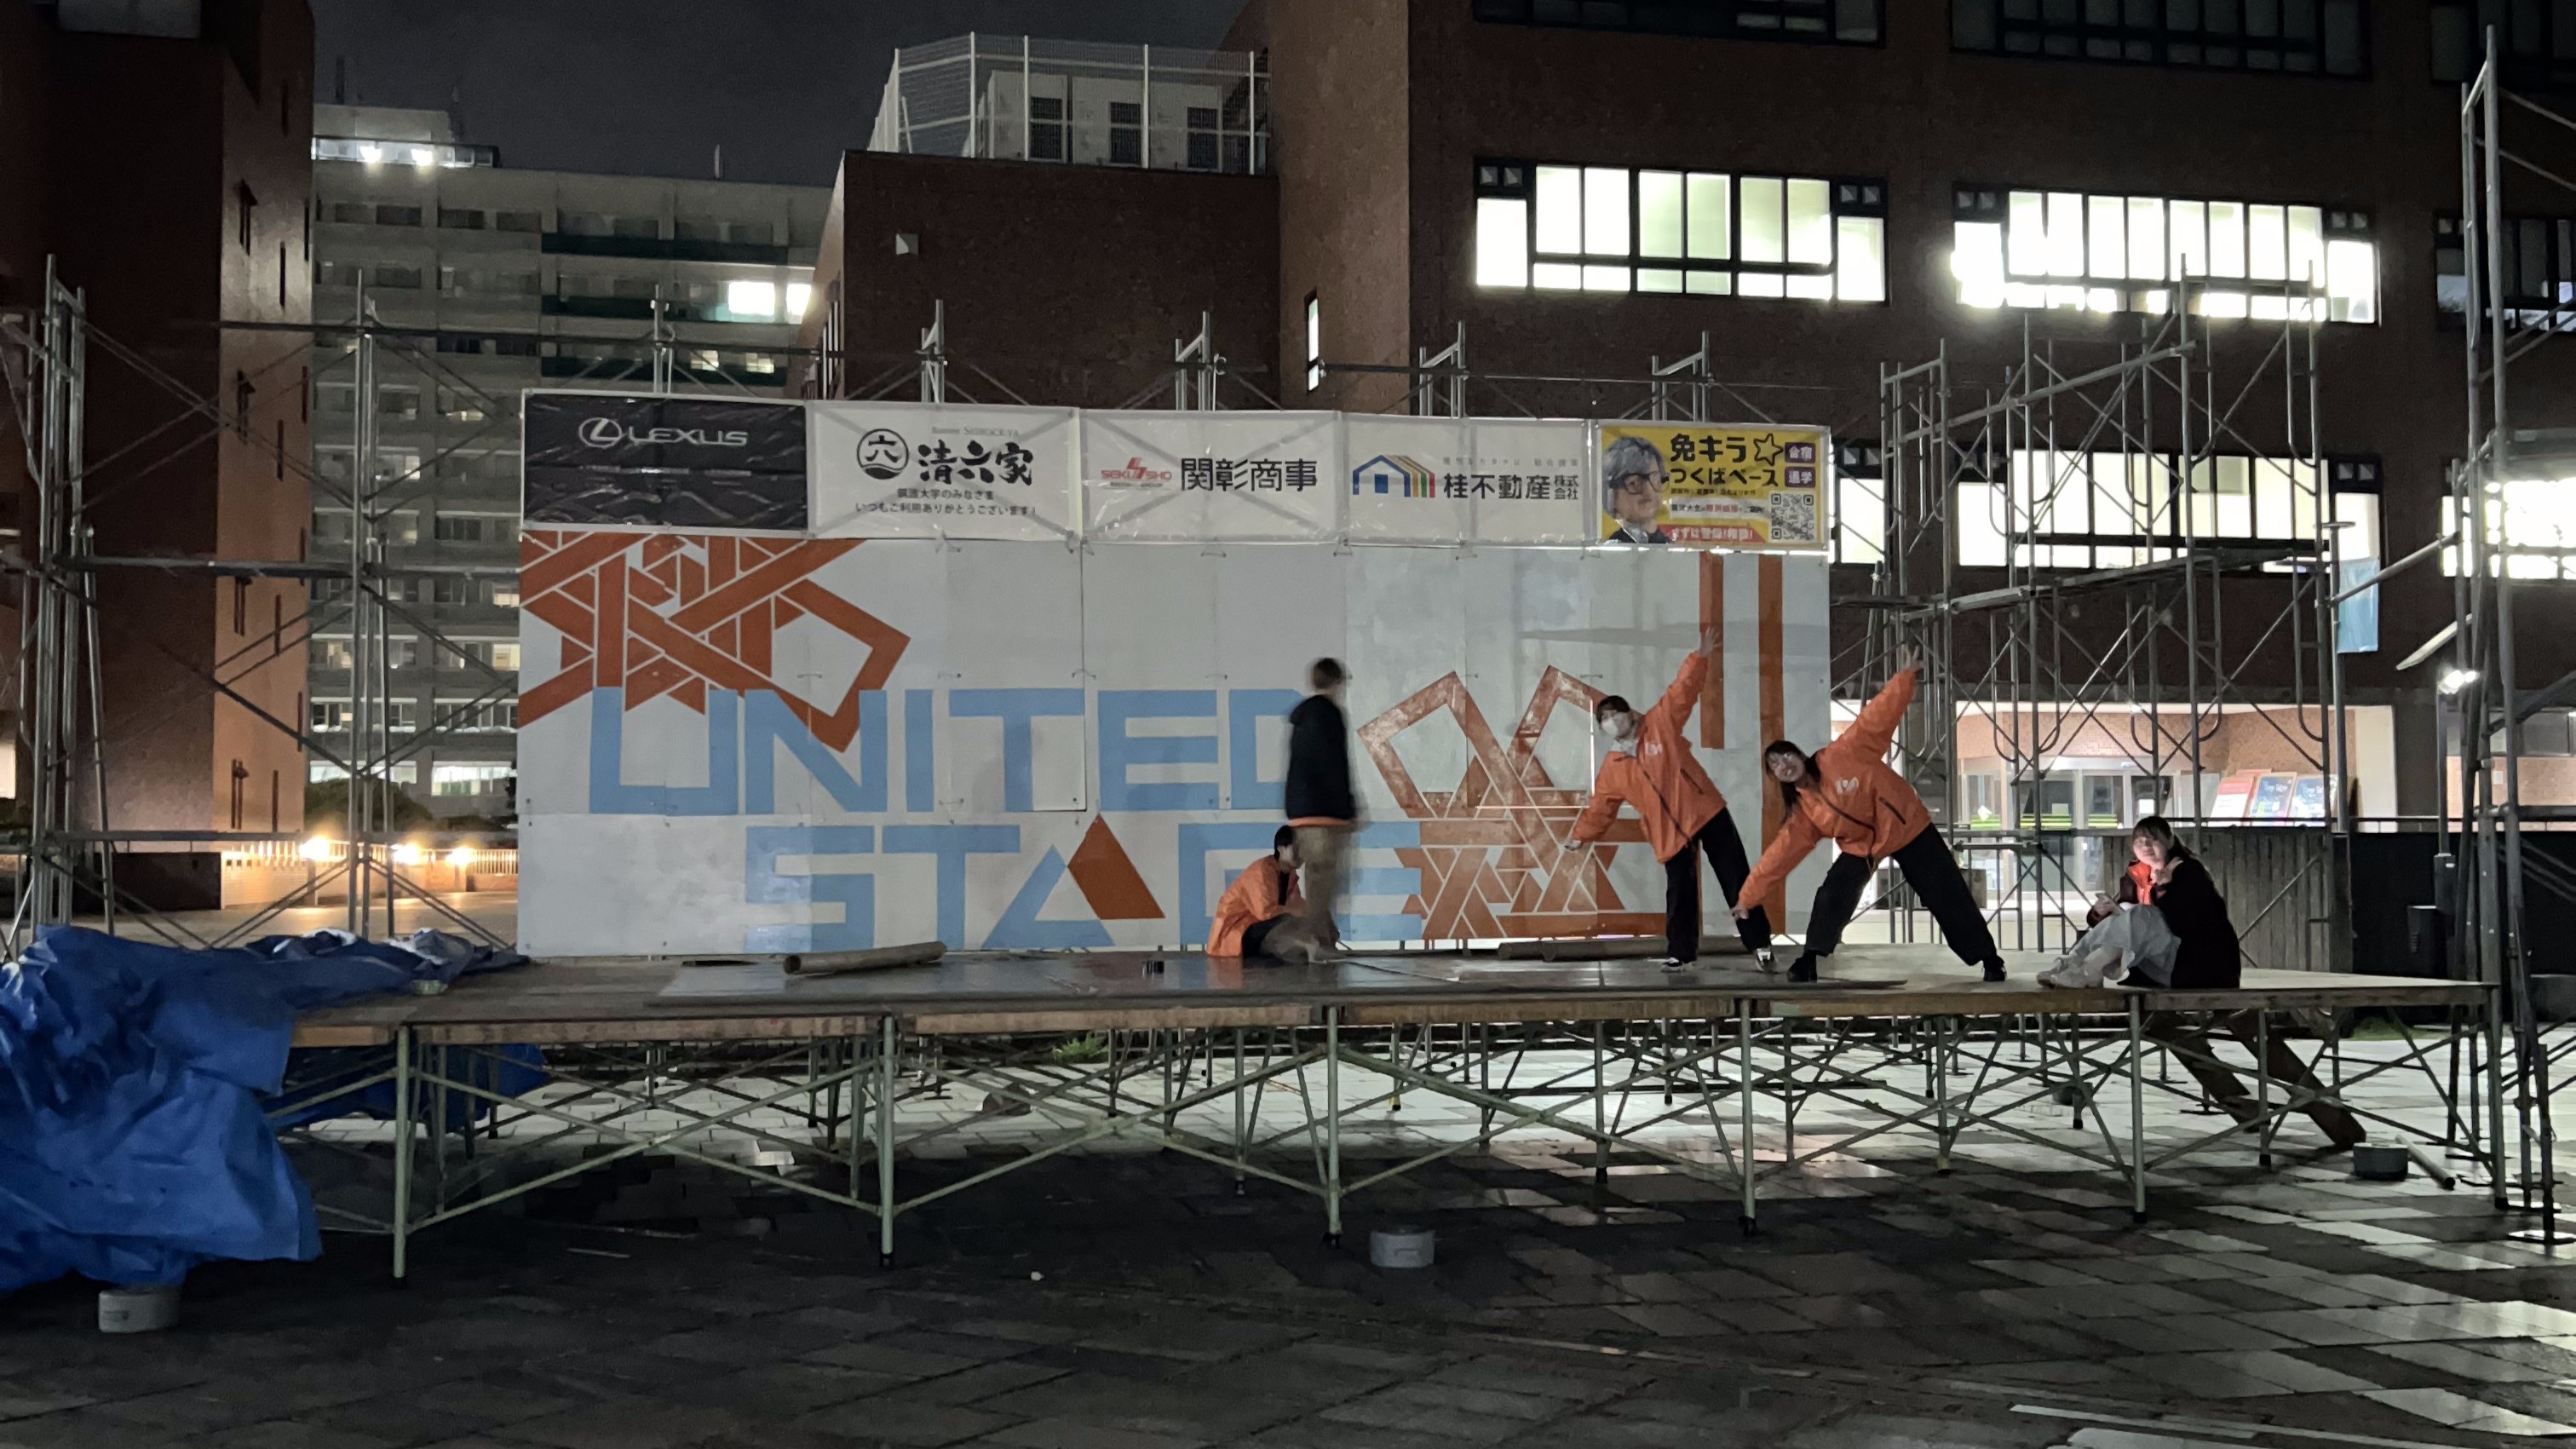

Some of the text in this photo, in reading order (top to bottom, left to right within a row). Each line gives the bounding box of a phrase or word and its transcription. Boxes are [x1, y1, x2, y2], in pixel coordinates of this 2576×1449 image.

[629, 426, 748, 446] LEXUS
[865, 434, 900, 463] 六
[917, 439, 1034, 486] 清六家
[1181, 457, 1319, 492] 関彰商事
[1670, 467, 1779, 487] つくばベース
[1443, 473, 1550, 500] 桂不動産
[589, 686, 1306, 817] UNITED
